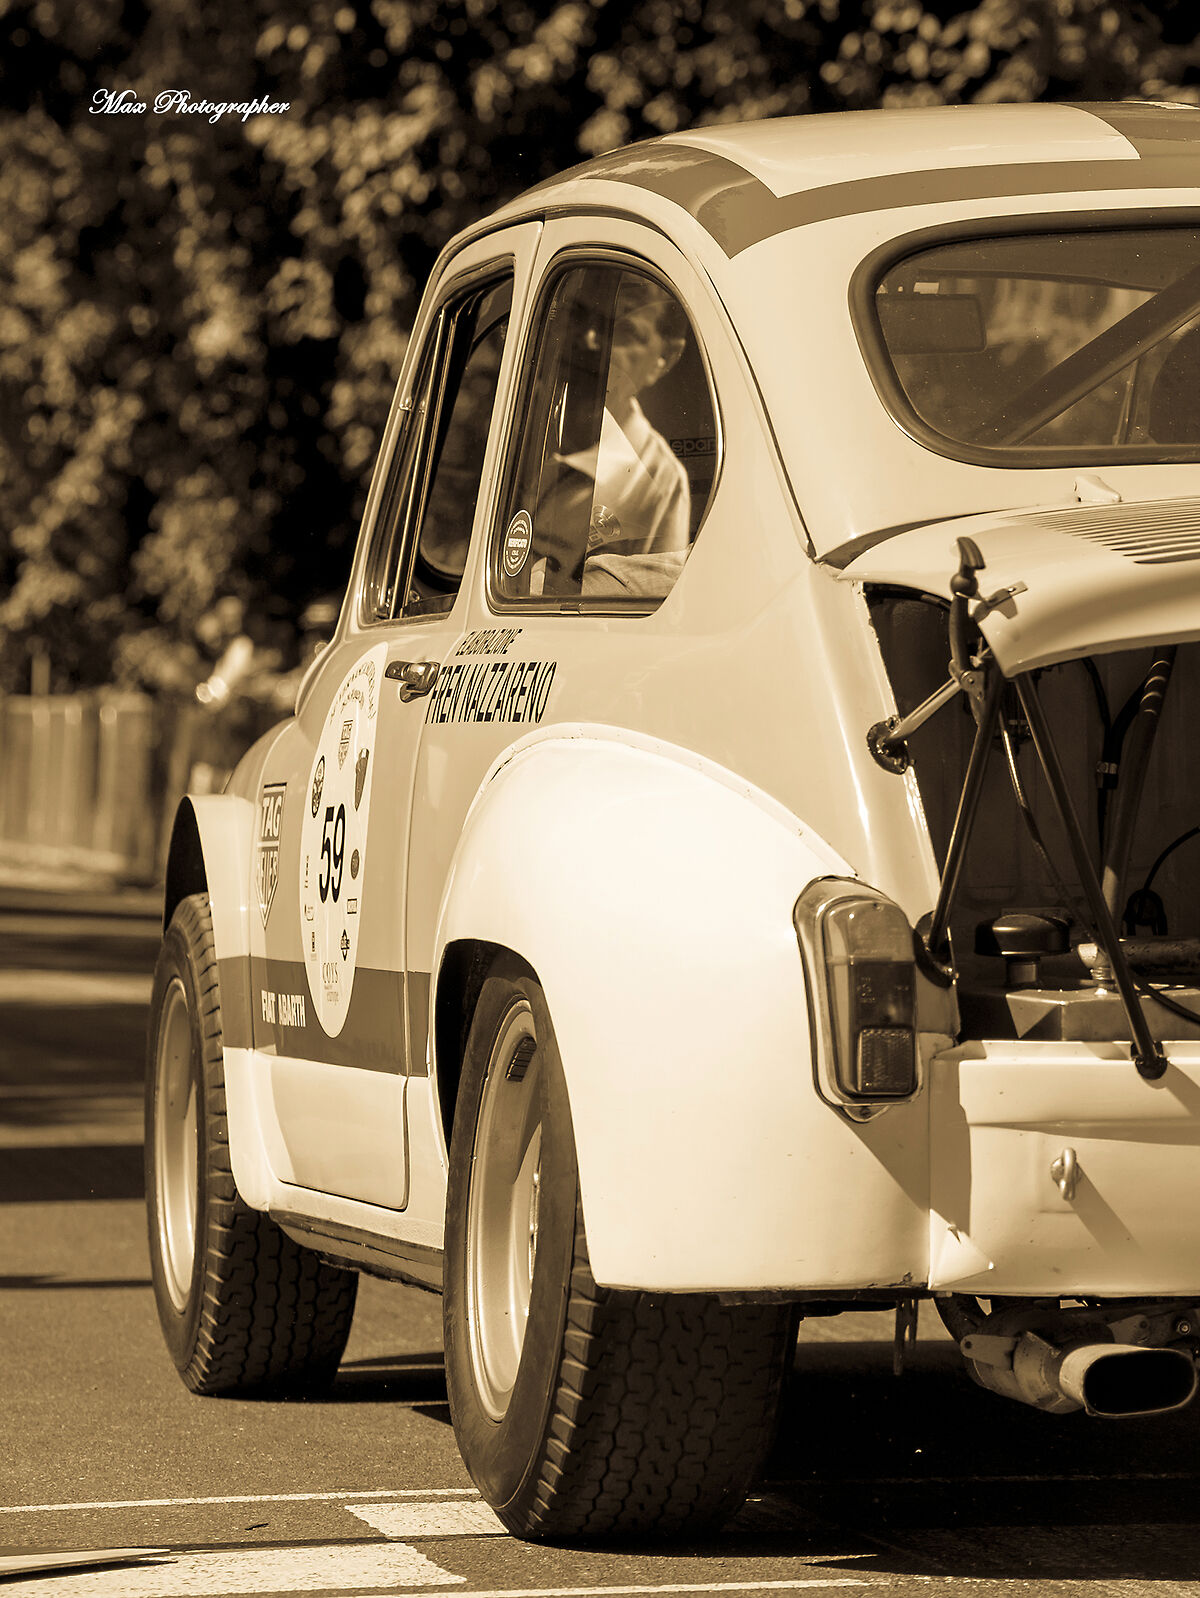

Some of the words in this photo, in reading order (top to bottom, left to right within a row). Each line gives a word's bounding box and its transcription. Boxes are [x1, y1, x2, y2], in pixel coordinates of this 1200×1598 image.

[457, 661, 557, 723] NAZZARENO
[261, 795, 282, 838] TAG
[318, 803, 346, 904] 59
[261, 989, 276, 1025] FIAT
[278, 993, 306, 1028] ABARTH
